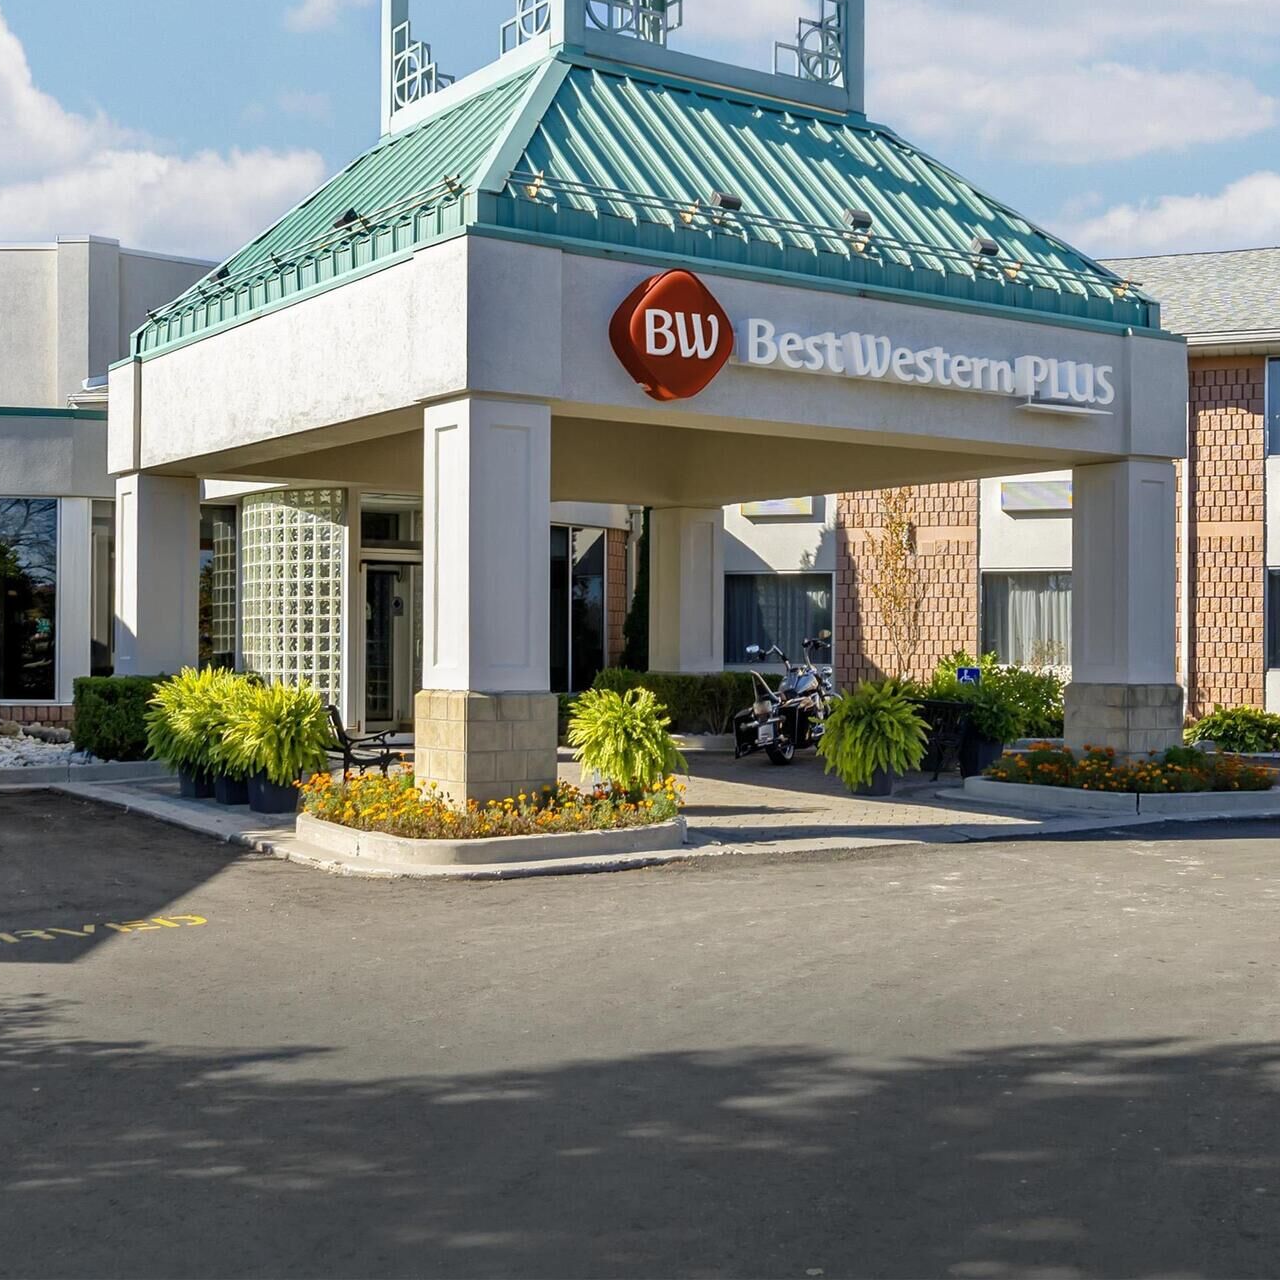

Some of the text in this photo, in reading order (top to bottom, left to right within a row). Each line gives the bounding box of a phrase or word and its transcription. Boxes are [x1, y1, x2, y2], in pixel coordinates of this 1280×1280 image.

[644, 308, 720, 360] BW
[746, 317, 1116, 405] Best Western PLUS
